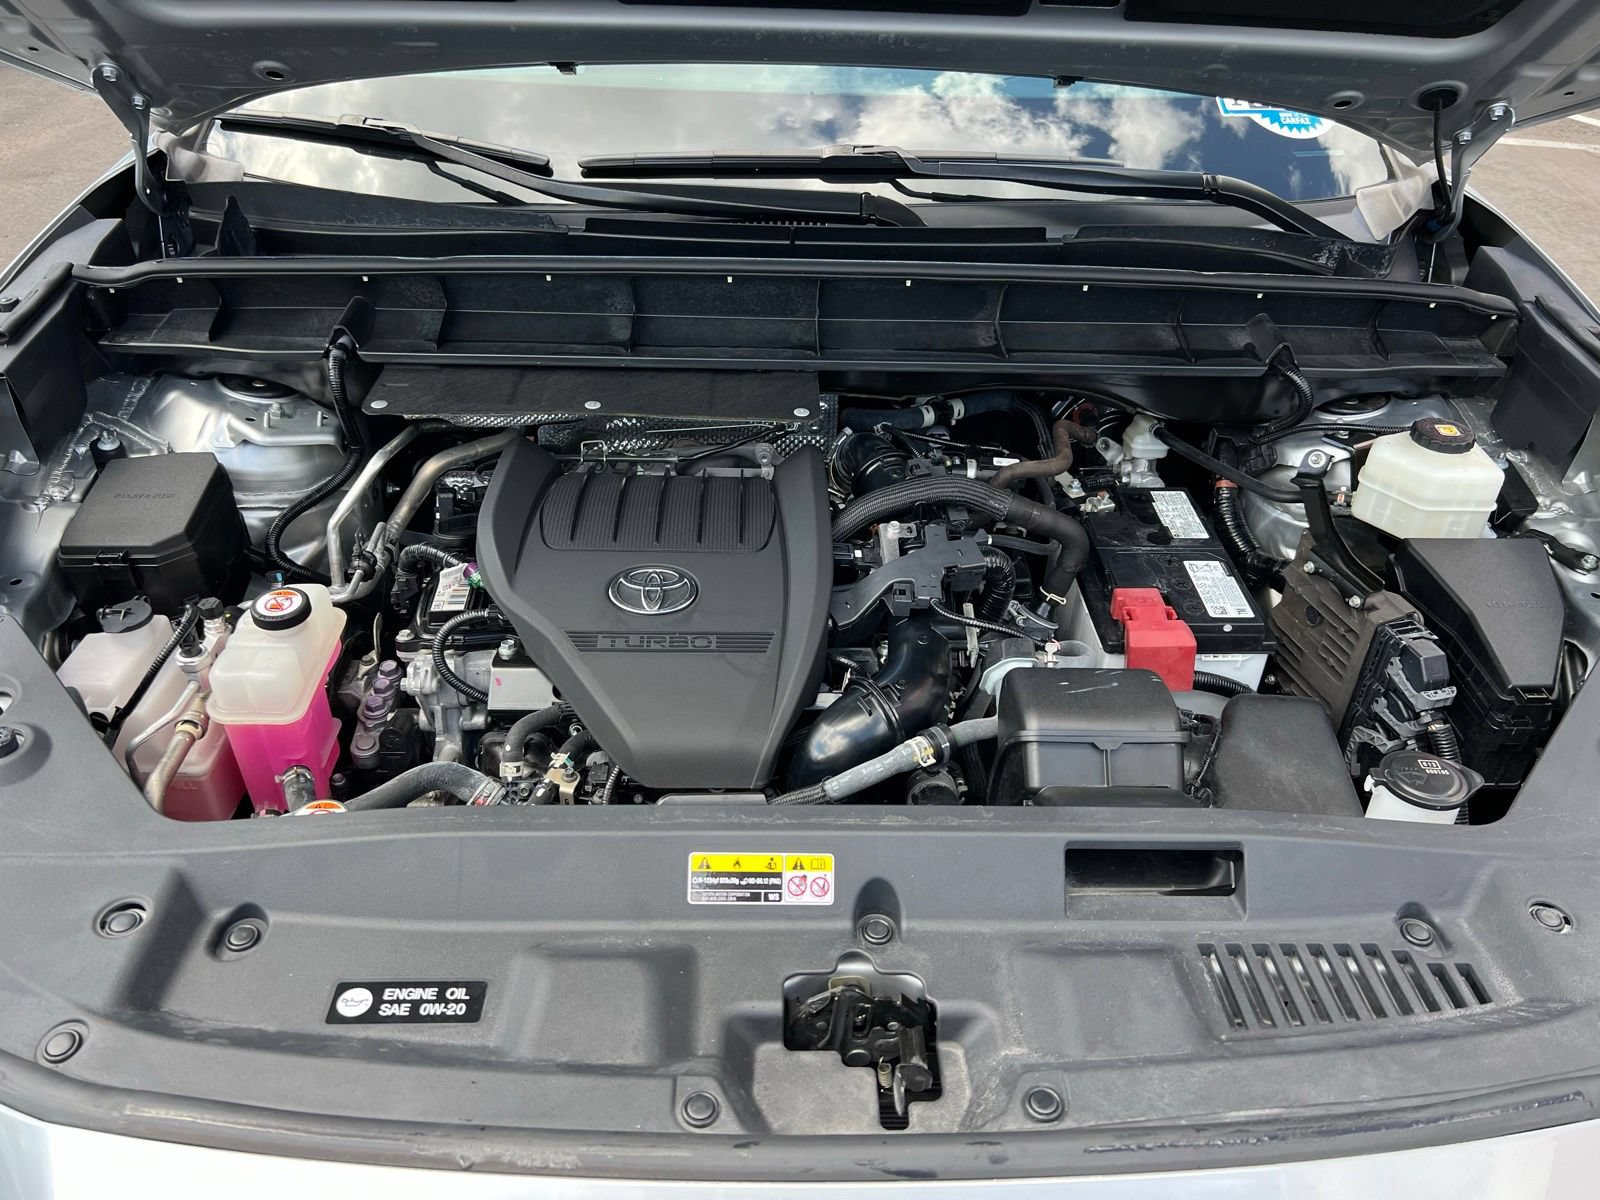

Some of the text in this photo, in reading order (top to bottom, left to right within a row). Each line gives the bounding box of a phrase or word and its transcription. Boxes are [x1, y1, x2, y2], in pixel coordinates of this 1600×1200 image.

[1281, 117, 1312, 125] CARFAX
[601, 634, 713, 649] TURBO
[382, 987, 471, 1000] ENGINE OIL
[378, 1003, 467, 1016] SAE 0W-20
